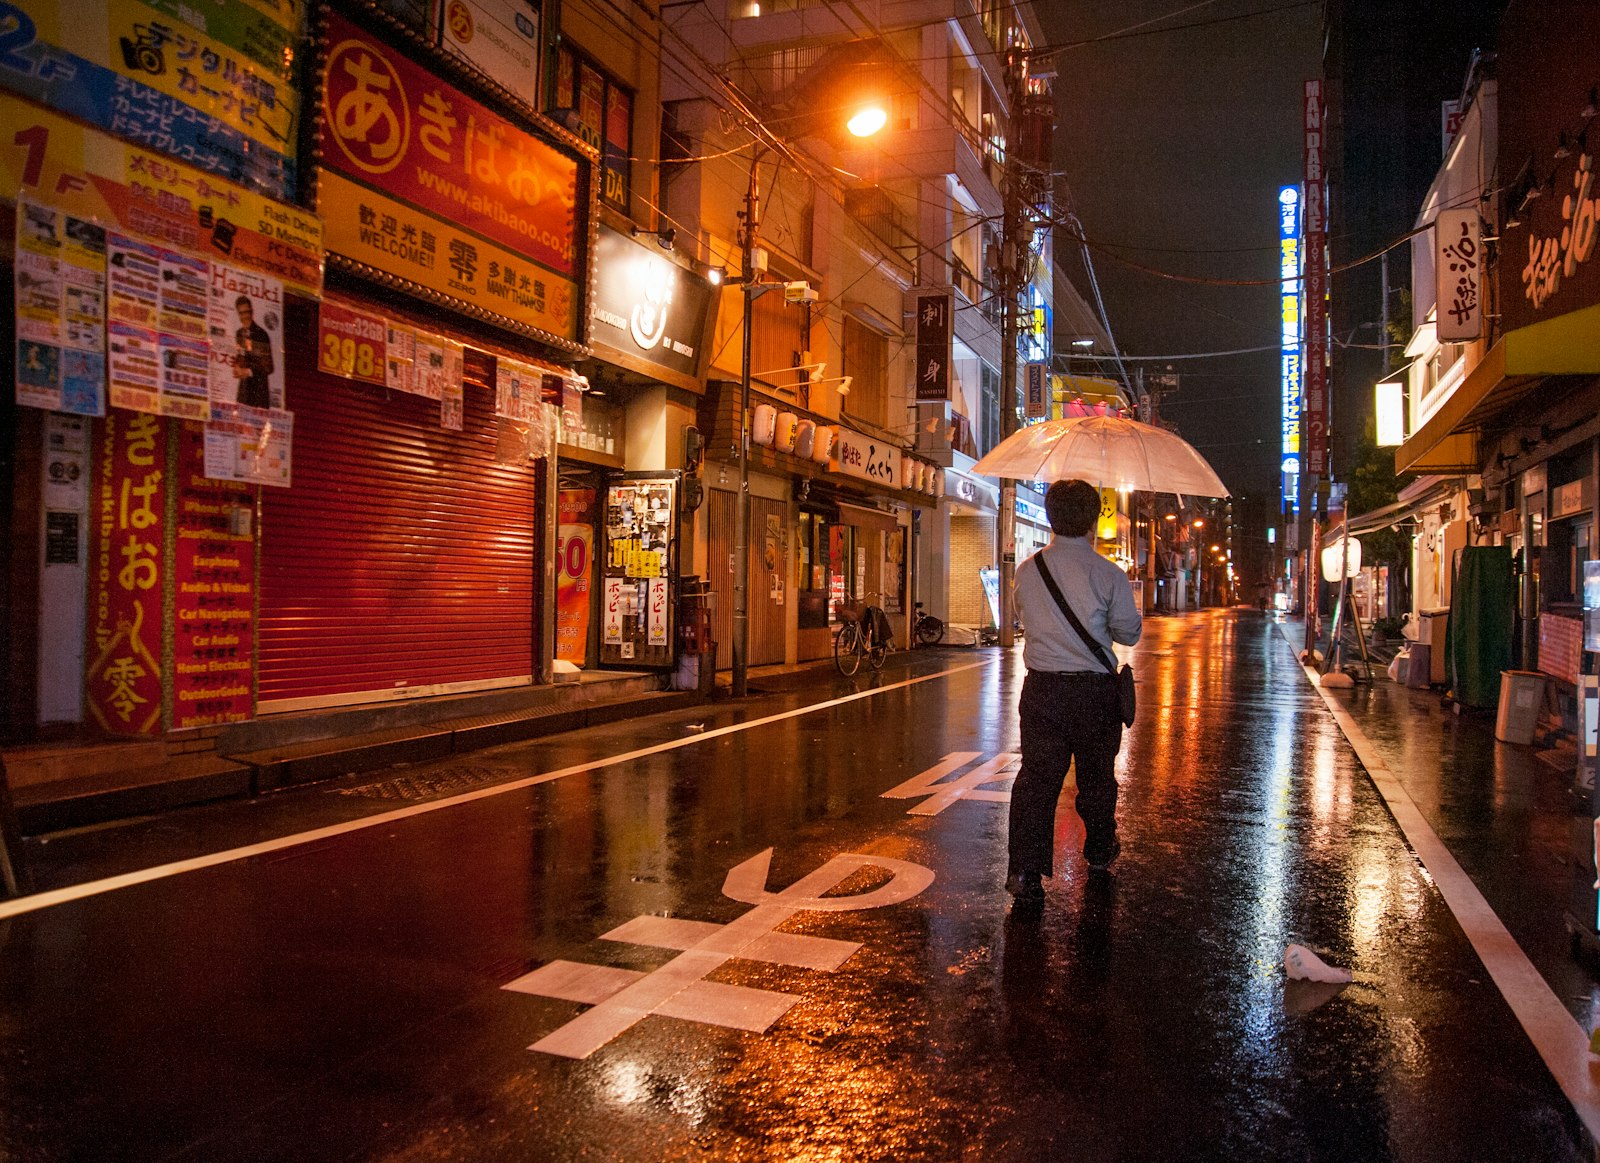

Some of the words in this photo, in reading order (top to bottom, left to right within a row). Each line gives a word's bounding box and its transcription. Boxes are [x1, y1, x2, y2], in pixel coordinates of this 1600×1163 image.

[1304, 81, 1323, 233] MANDARAKE
[258, 220, 273, 236] SD
[276, 226, 319, 253] Memory
[264, 205, 289, 225] Flash
[292, 217, 319, 237] Drive
[448, 237, 478, 282] 零
[1443, 222, 1477, 325] キッチンジロー
[212, 264, 279, 304] Hazuki
[447, 279, 477, 296] ZERO
[486, 279, 510, 301] MANY
[323, 333, 375, 377] 398
[921, 303, 943, 383] 刺身
[575, 579, 588, 592] 円
[652, 583, 666, 624] ホッピー
